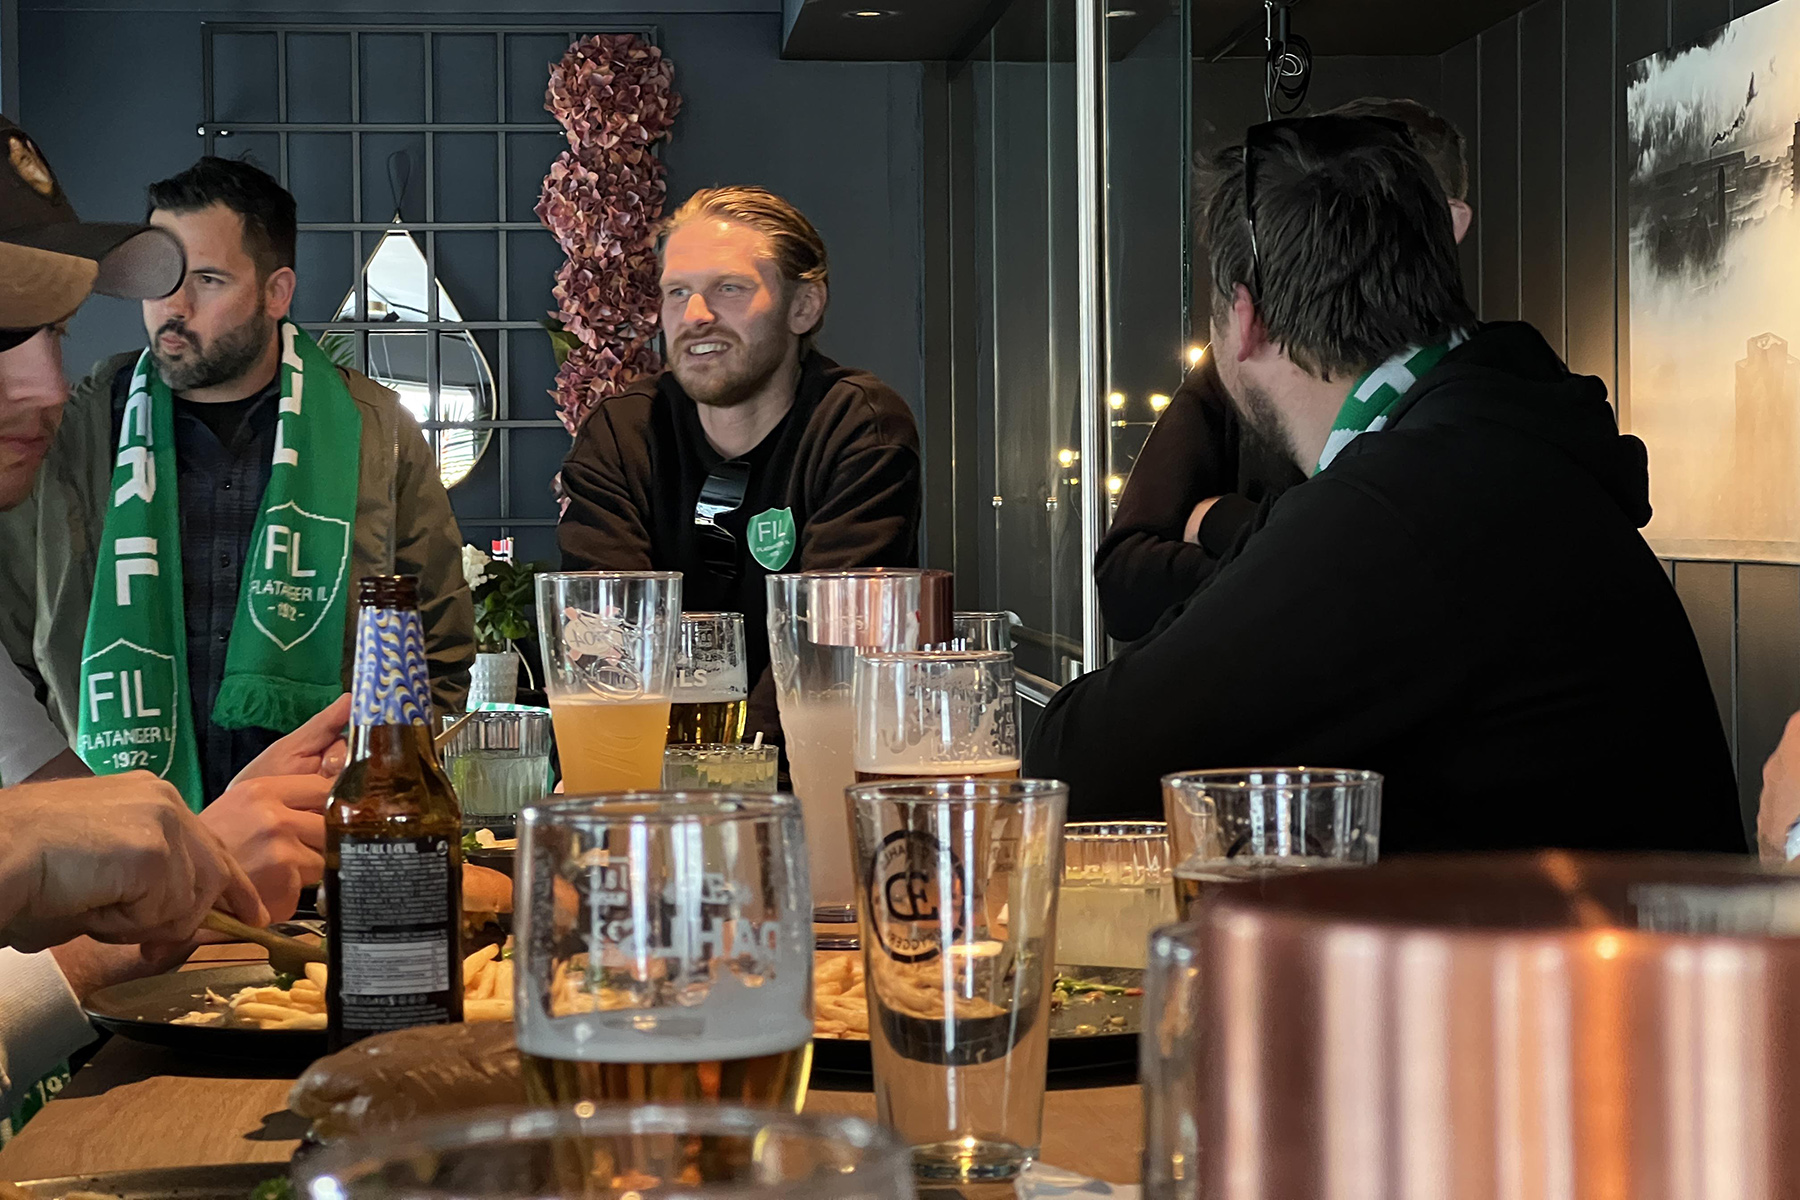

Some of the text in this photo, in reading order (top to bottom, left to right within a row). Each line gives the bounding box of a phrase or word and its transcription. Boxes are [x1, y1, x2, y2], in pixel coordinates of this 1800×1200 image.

[757, 519, 787, 542] FIL
[673, 669, 708, 688] LS
[88, 669, 161, 723] FIL
